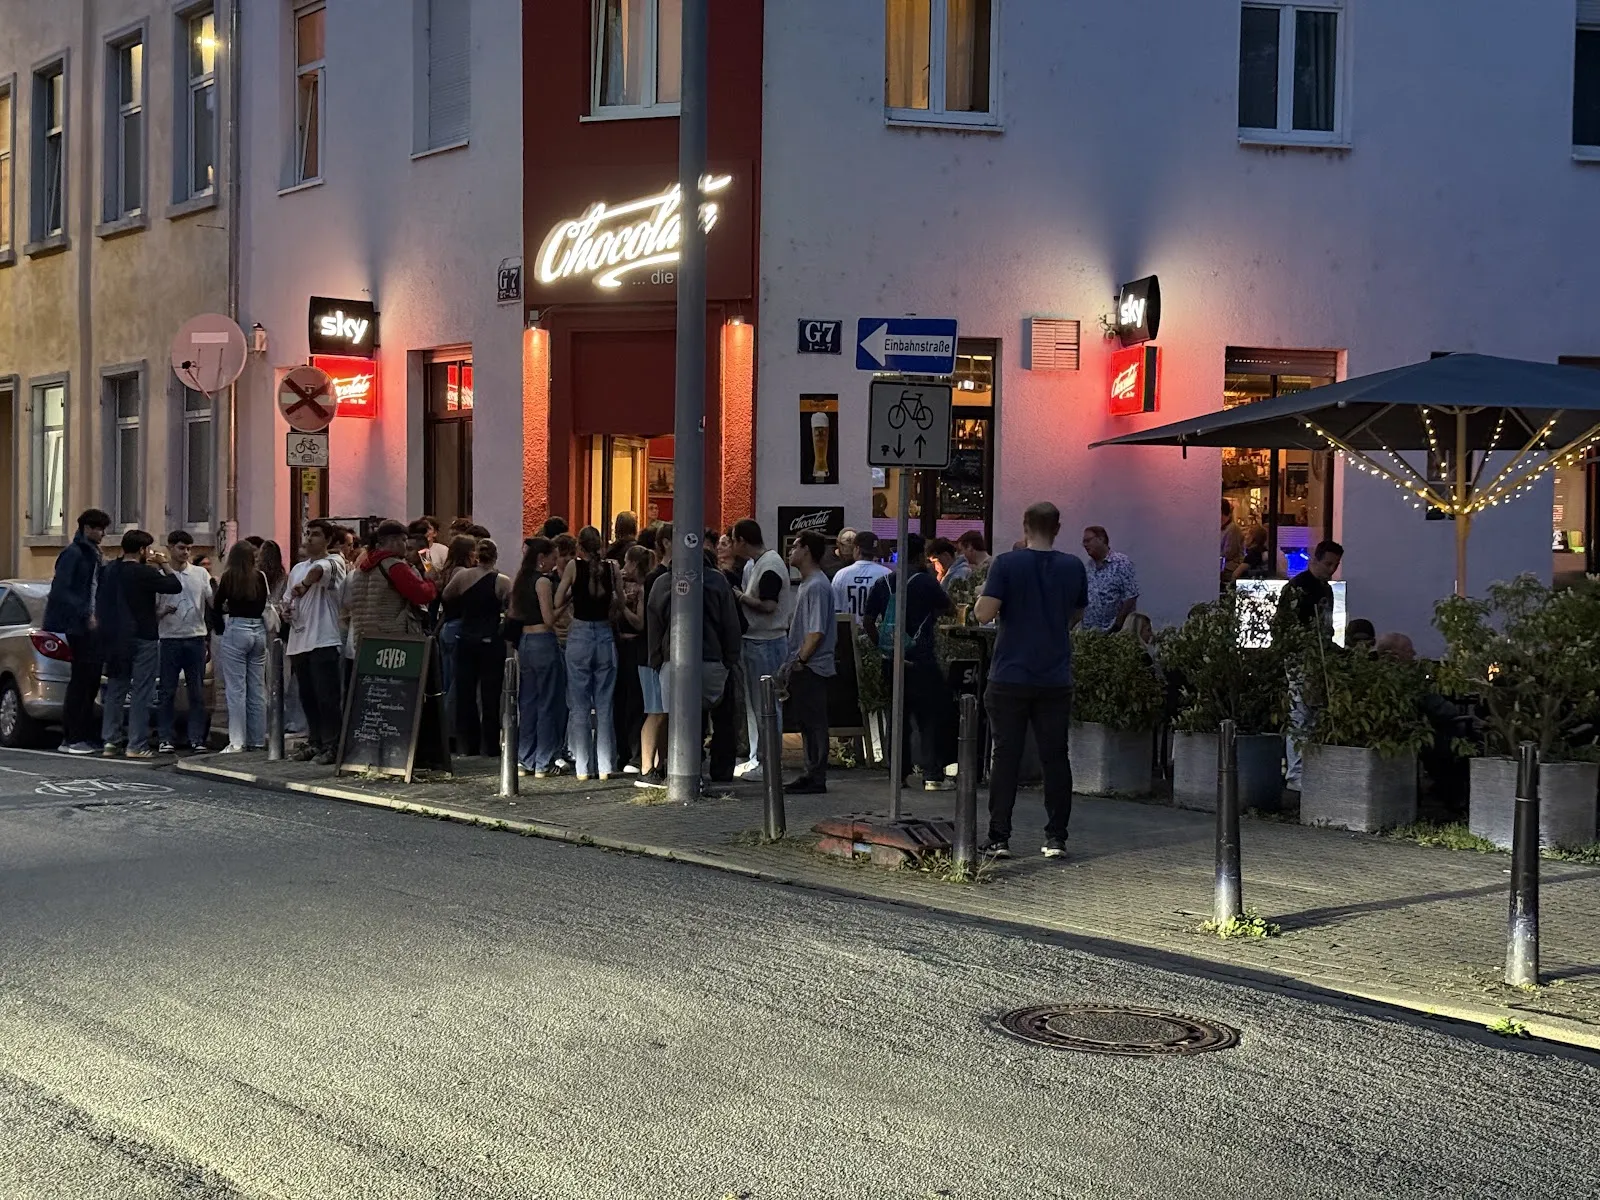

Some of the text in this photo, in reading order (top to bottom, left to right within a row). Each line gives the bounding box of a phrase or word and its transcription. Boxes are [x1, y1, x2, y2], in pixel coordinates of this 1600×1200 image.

[500, 269, 518, 290] G7
[651, 269, 674, 285] die
[1120, 294, 1145, 328] sky
[320, 310, 369, 344] sky
[805, 322, 836, 343] G7
[884, 338, 950, 354] Einbahnstraße
[789, 509, 833, 532] Chocolate
[376, 647, 407, 669] JEVER
